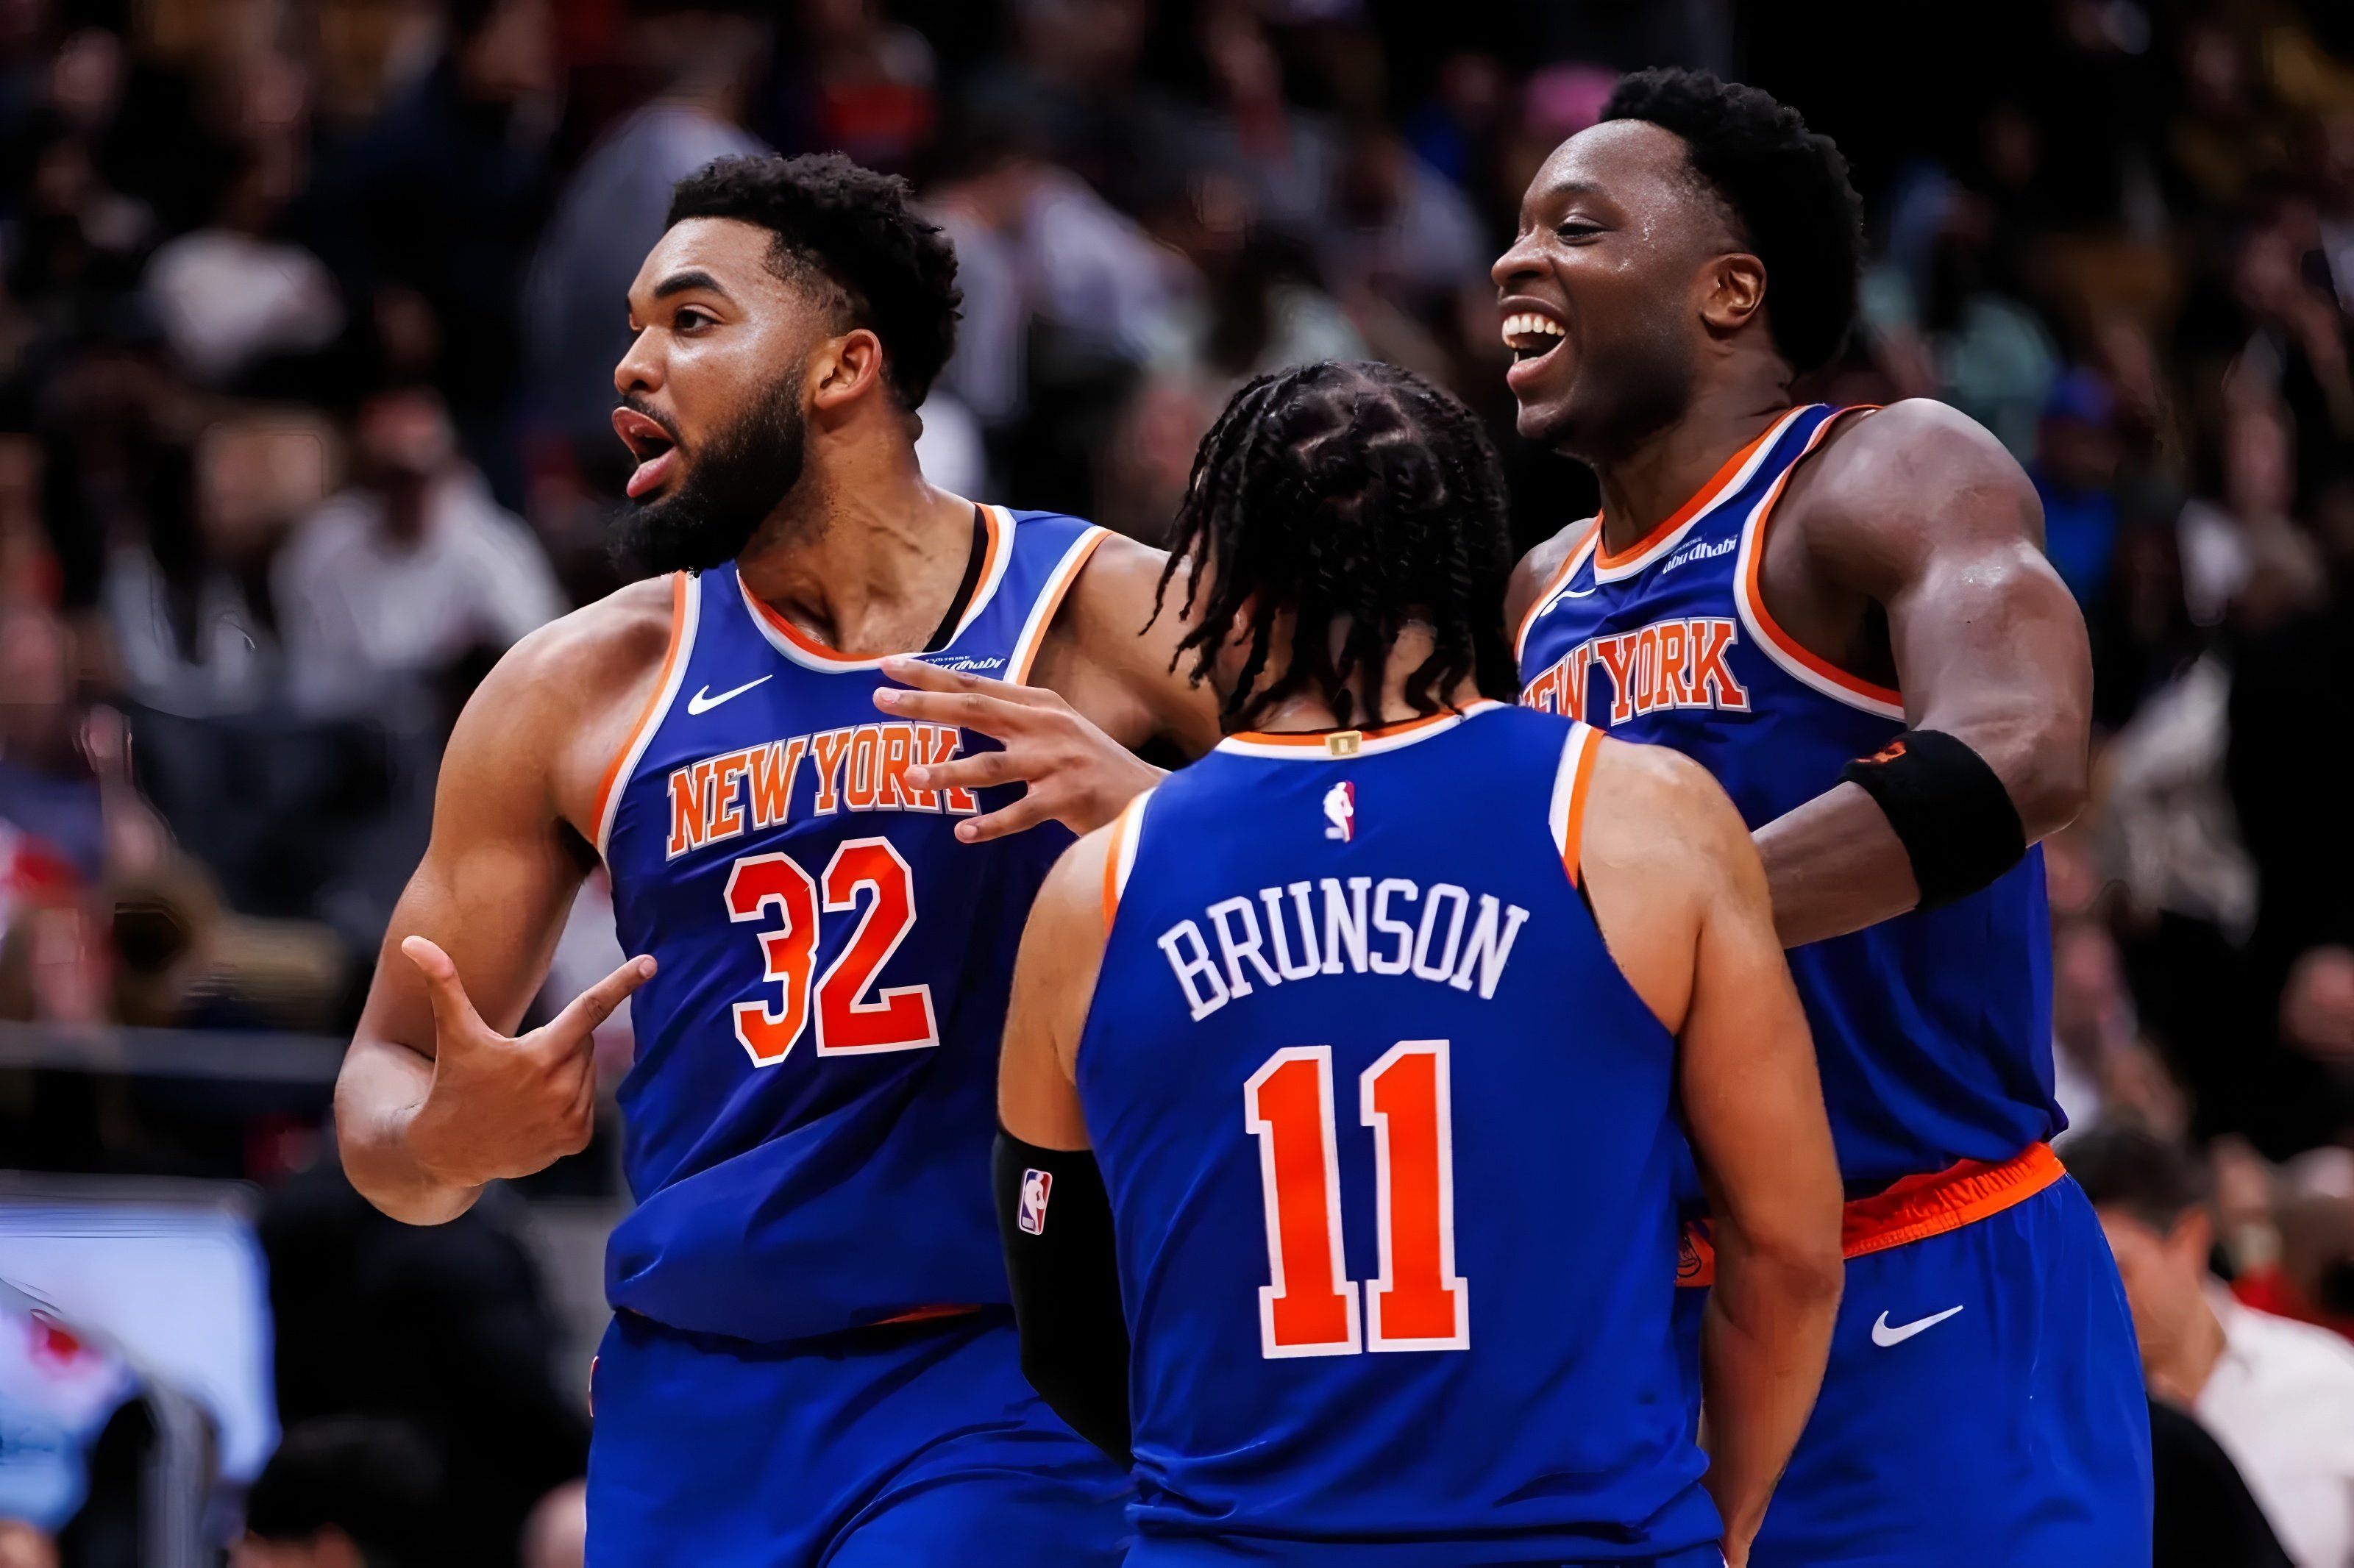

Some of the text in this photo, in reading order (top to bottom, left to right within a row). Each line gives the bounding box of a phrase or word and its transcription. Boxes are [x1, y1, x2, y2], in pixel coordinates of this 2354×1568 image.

[1519, 617, 1752, 727] EW YORK
[666, 721, 982, 862] NEW YORK
[724, 835, 940, 1068] 32
[1157, 877, 1530, 1022] BRUNSON
[1243, 1038, 1470, 1359] 11
